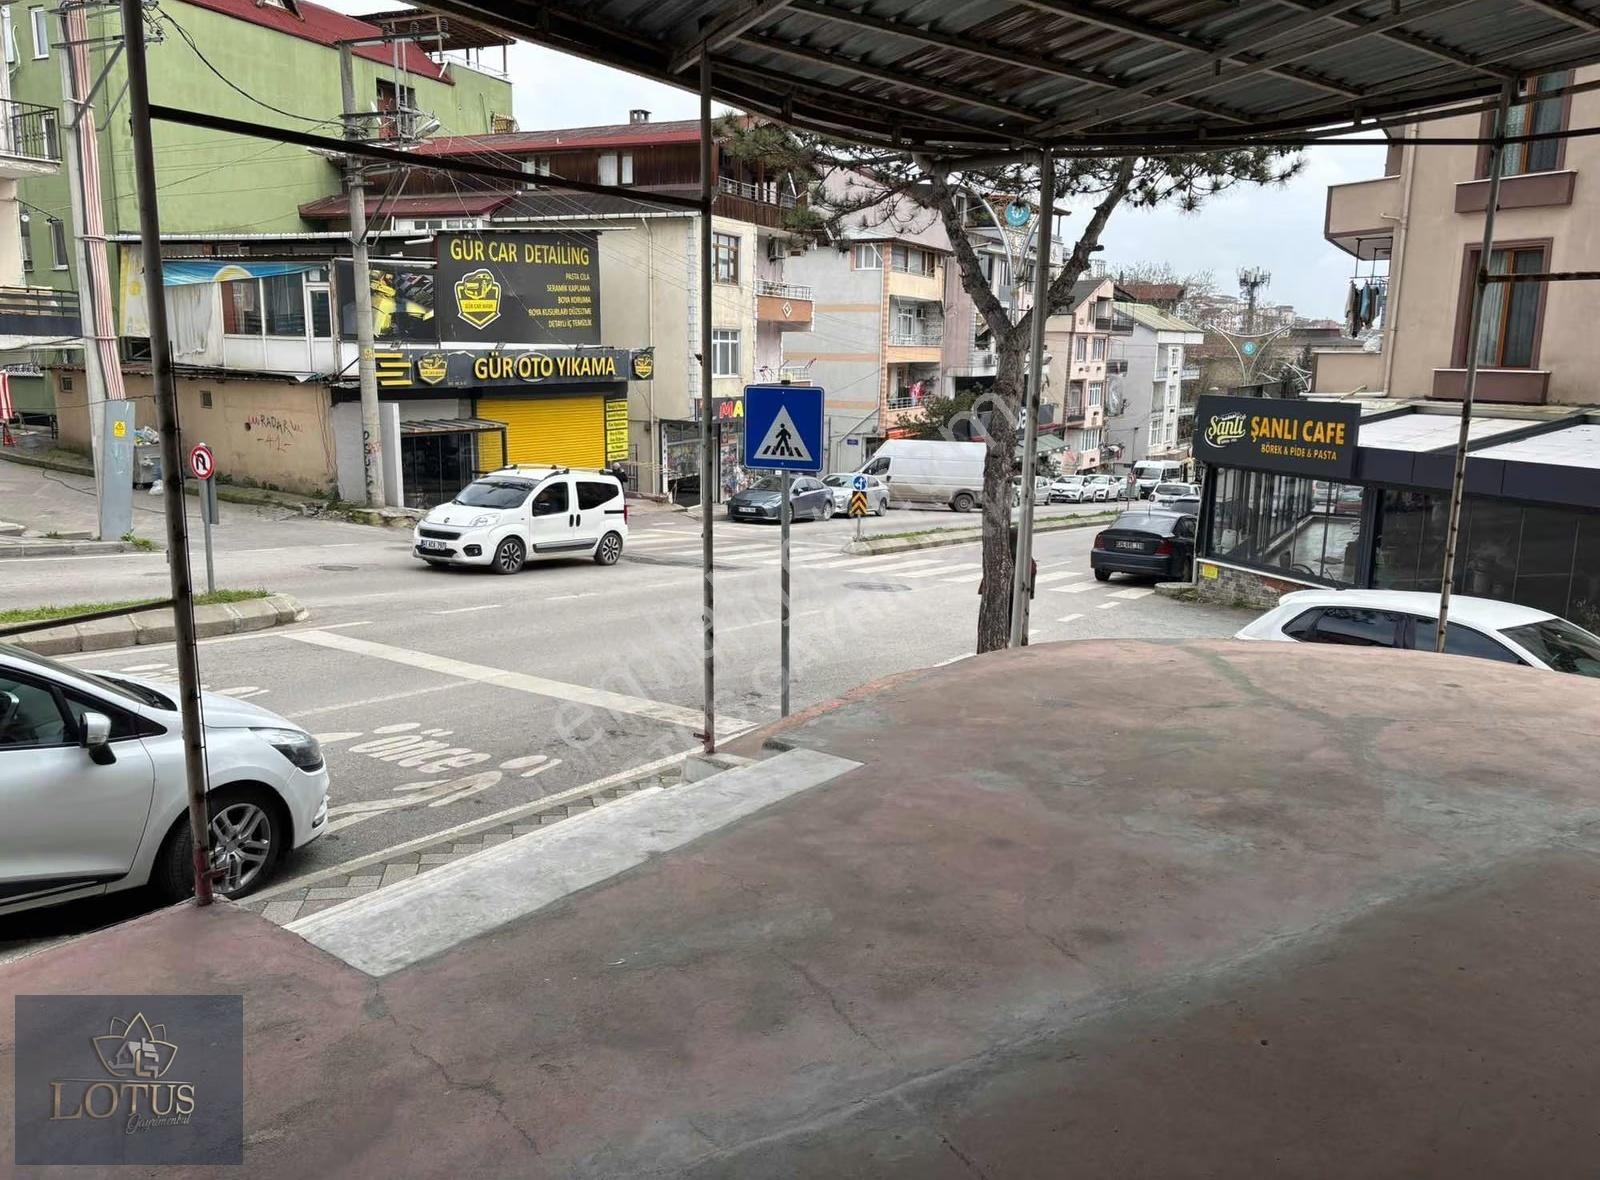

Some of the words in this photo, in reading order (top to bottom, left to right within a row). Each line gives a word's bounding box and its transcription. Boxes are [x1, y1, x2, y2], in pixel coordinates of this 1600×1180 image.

[450, 235, 485, 262] GÜR
[488, 241, 518, 263] CAR
[525, 241, 590, 266] DETAİLİNG
[474, 352, 513, 379] GÜR
[518, 356, 553, 378] OTO
[556, 356, 617, 377] YIKAMA
[1251, 415, 1298, 443] ŞANLI
[1302, 420, 1345, 445] CAFE
[1261, 442, 1283, 455] BÖREK
[1313, 450, 1337, 461] PASTA
